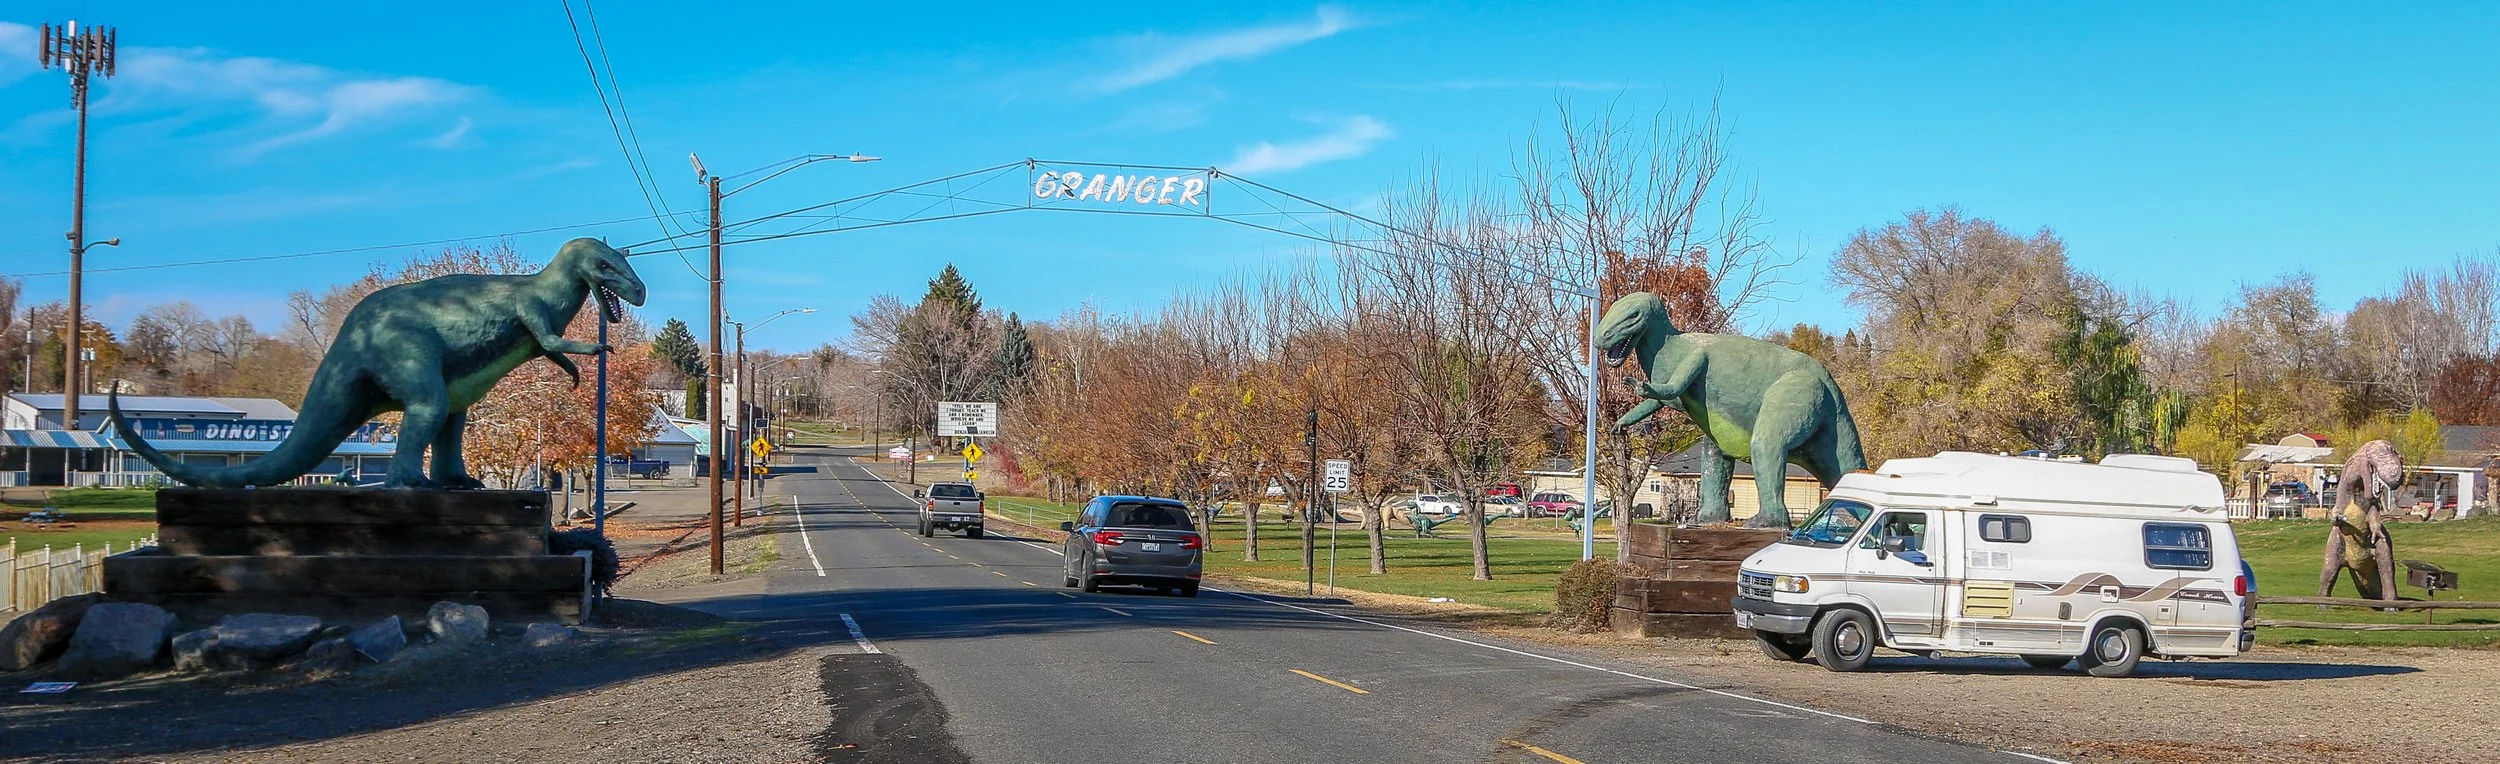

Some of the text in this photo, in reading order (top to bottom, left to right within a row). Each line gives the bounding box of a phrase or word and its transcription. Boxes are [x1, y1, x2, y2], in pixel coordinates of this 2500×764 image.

[1034, 171, 1205, 206] GRANGER
[206, 423, 294, 440] DINO ST
[1327, 477, 1346, 488] 25
